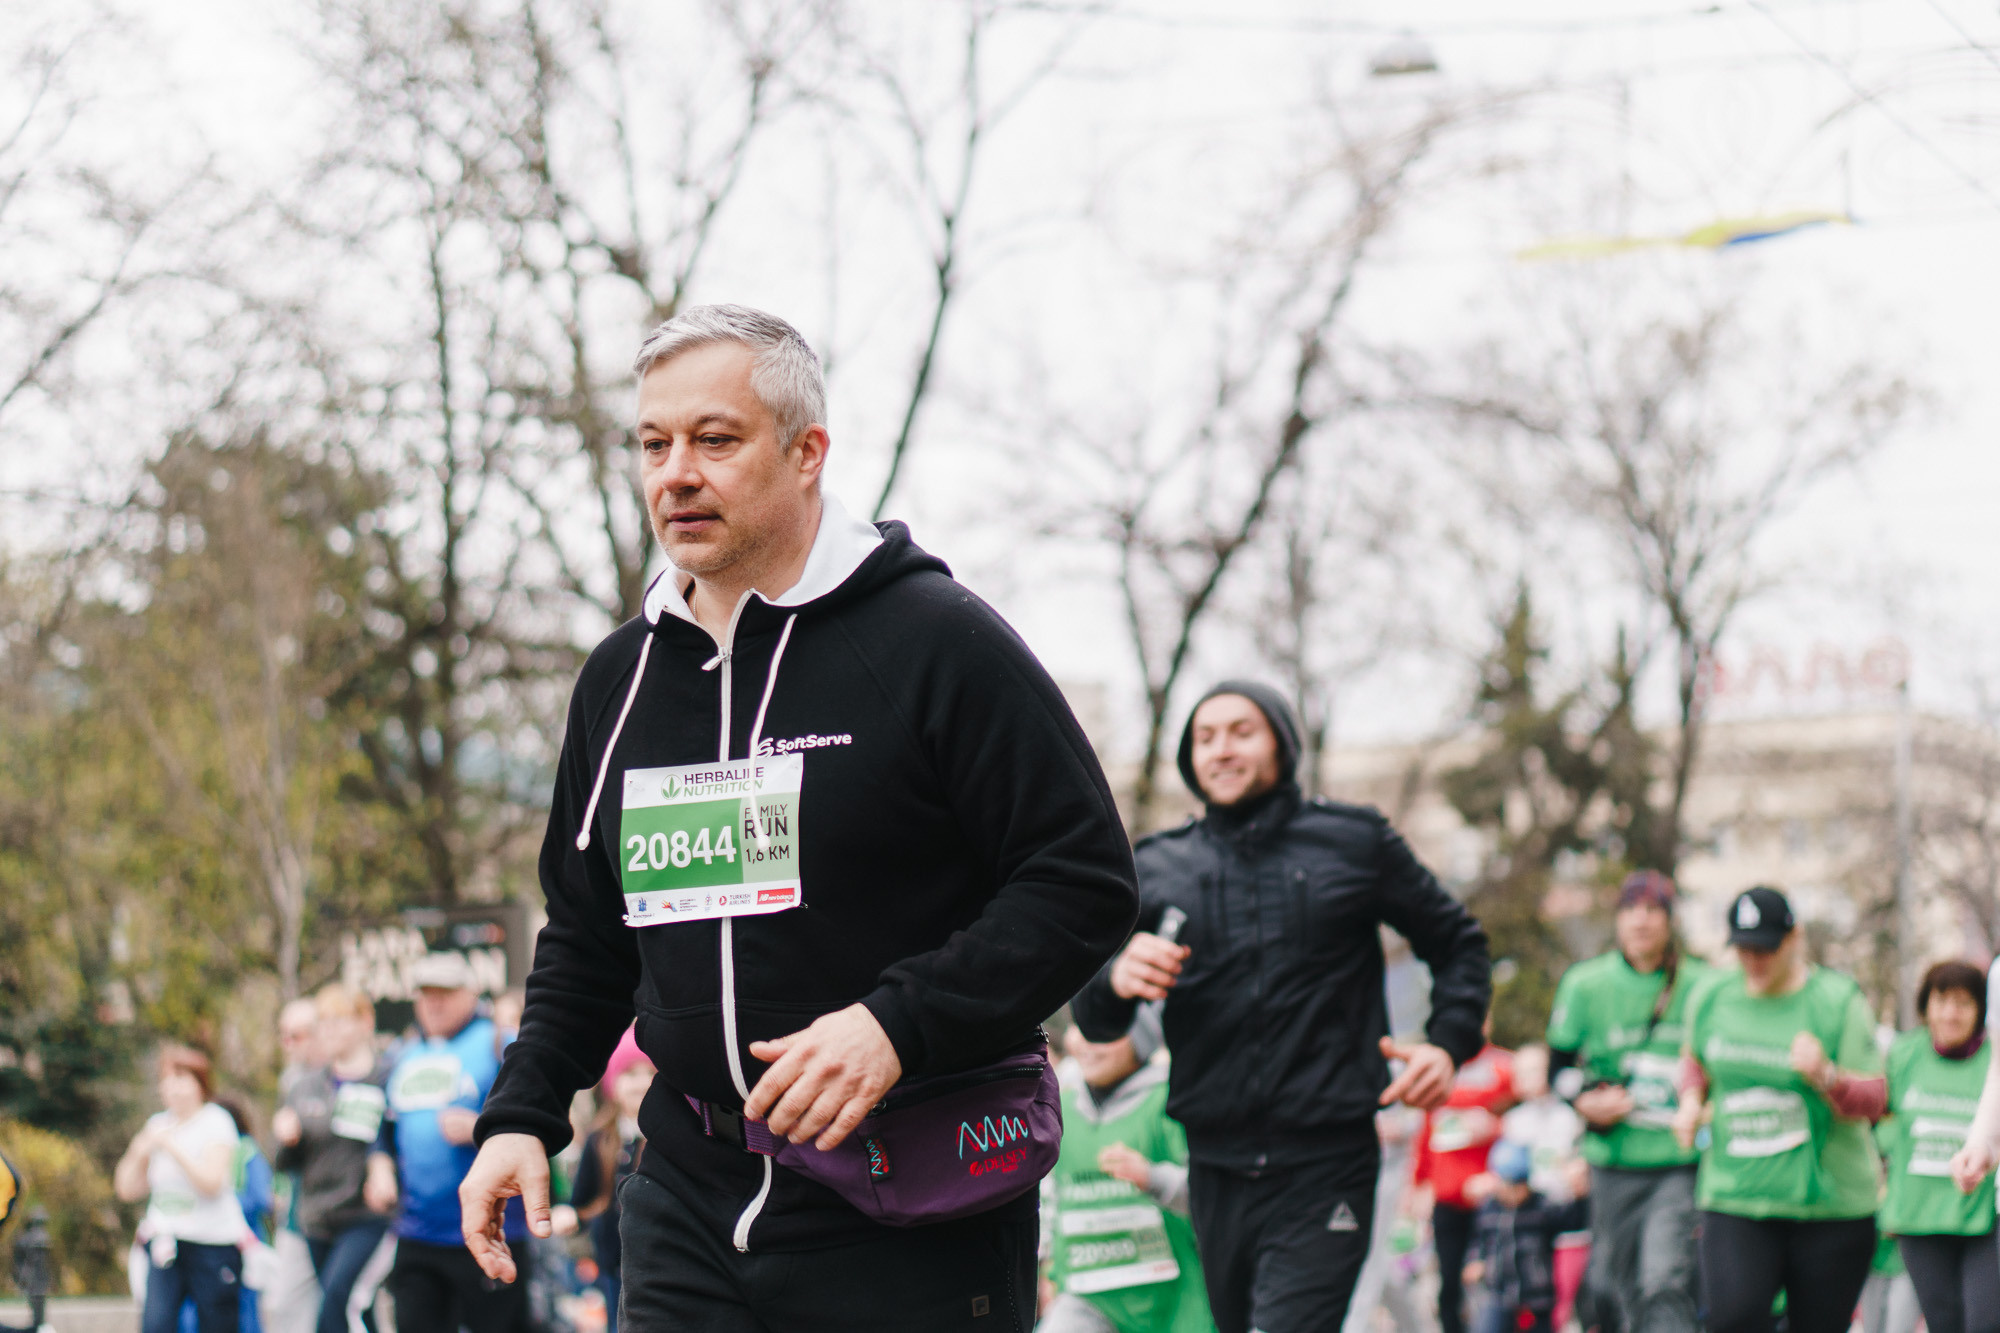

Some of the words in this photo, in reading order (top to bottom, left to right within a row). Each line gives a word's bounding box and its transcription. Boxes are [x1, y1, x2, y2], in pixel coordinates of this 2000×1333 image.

[776, 734, 852, 753] SoftServe
[744, 803, 788, 818] FMILY
[744, 816, 788, 839] RUN
[626, 825, 737, 872] 20844
[745, 848, 764, 864] 1,6
[768, 844, 790, 860] KM
[984, 1146, 1028, 1172] DELSEY
